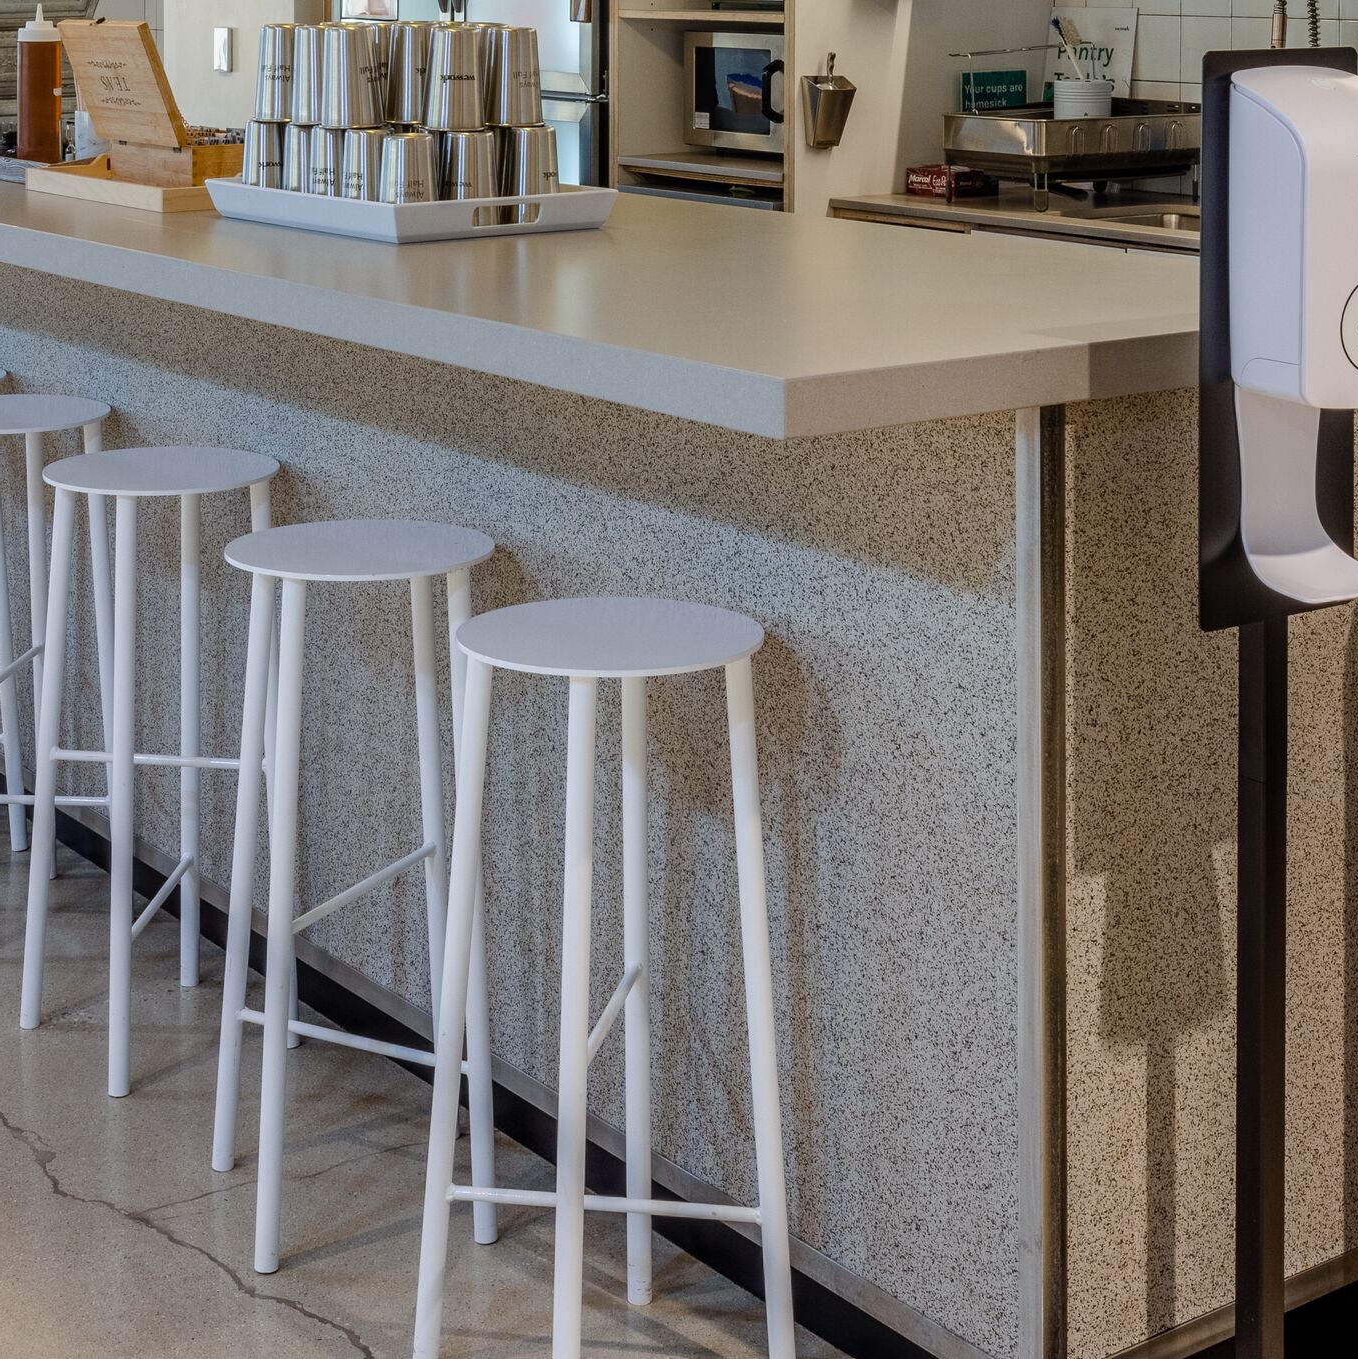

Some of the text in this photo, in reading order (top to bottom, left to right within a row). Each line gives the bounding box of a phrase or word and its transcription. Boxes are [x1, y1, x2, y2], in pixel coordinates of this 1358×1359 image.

[100, 76, 131, 92] TEAS
[440, 74, 475, 85] wework
[986, 85, 1007, 95] cups
[1009, 84, 1023, 92] are
[965, 98, 1008, 109] hmesick.
[908, 174, 931, 183] Marcal
